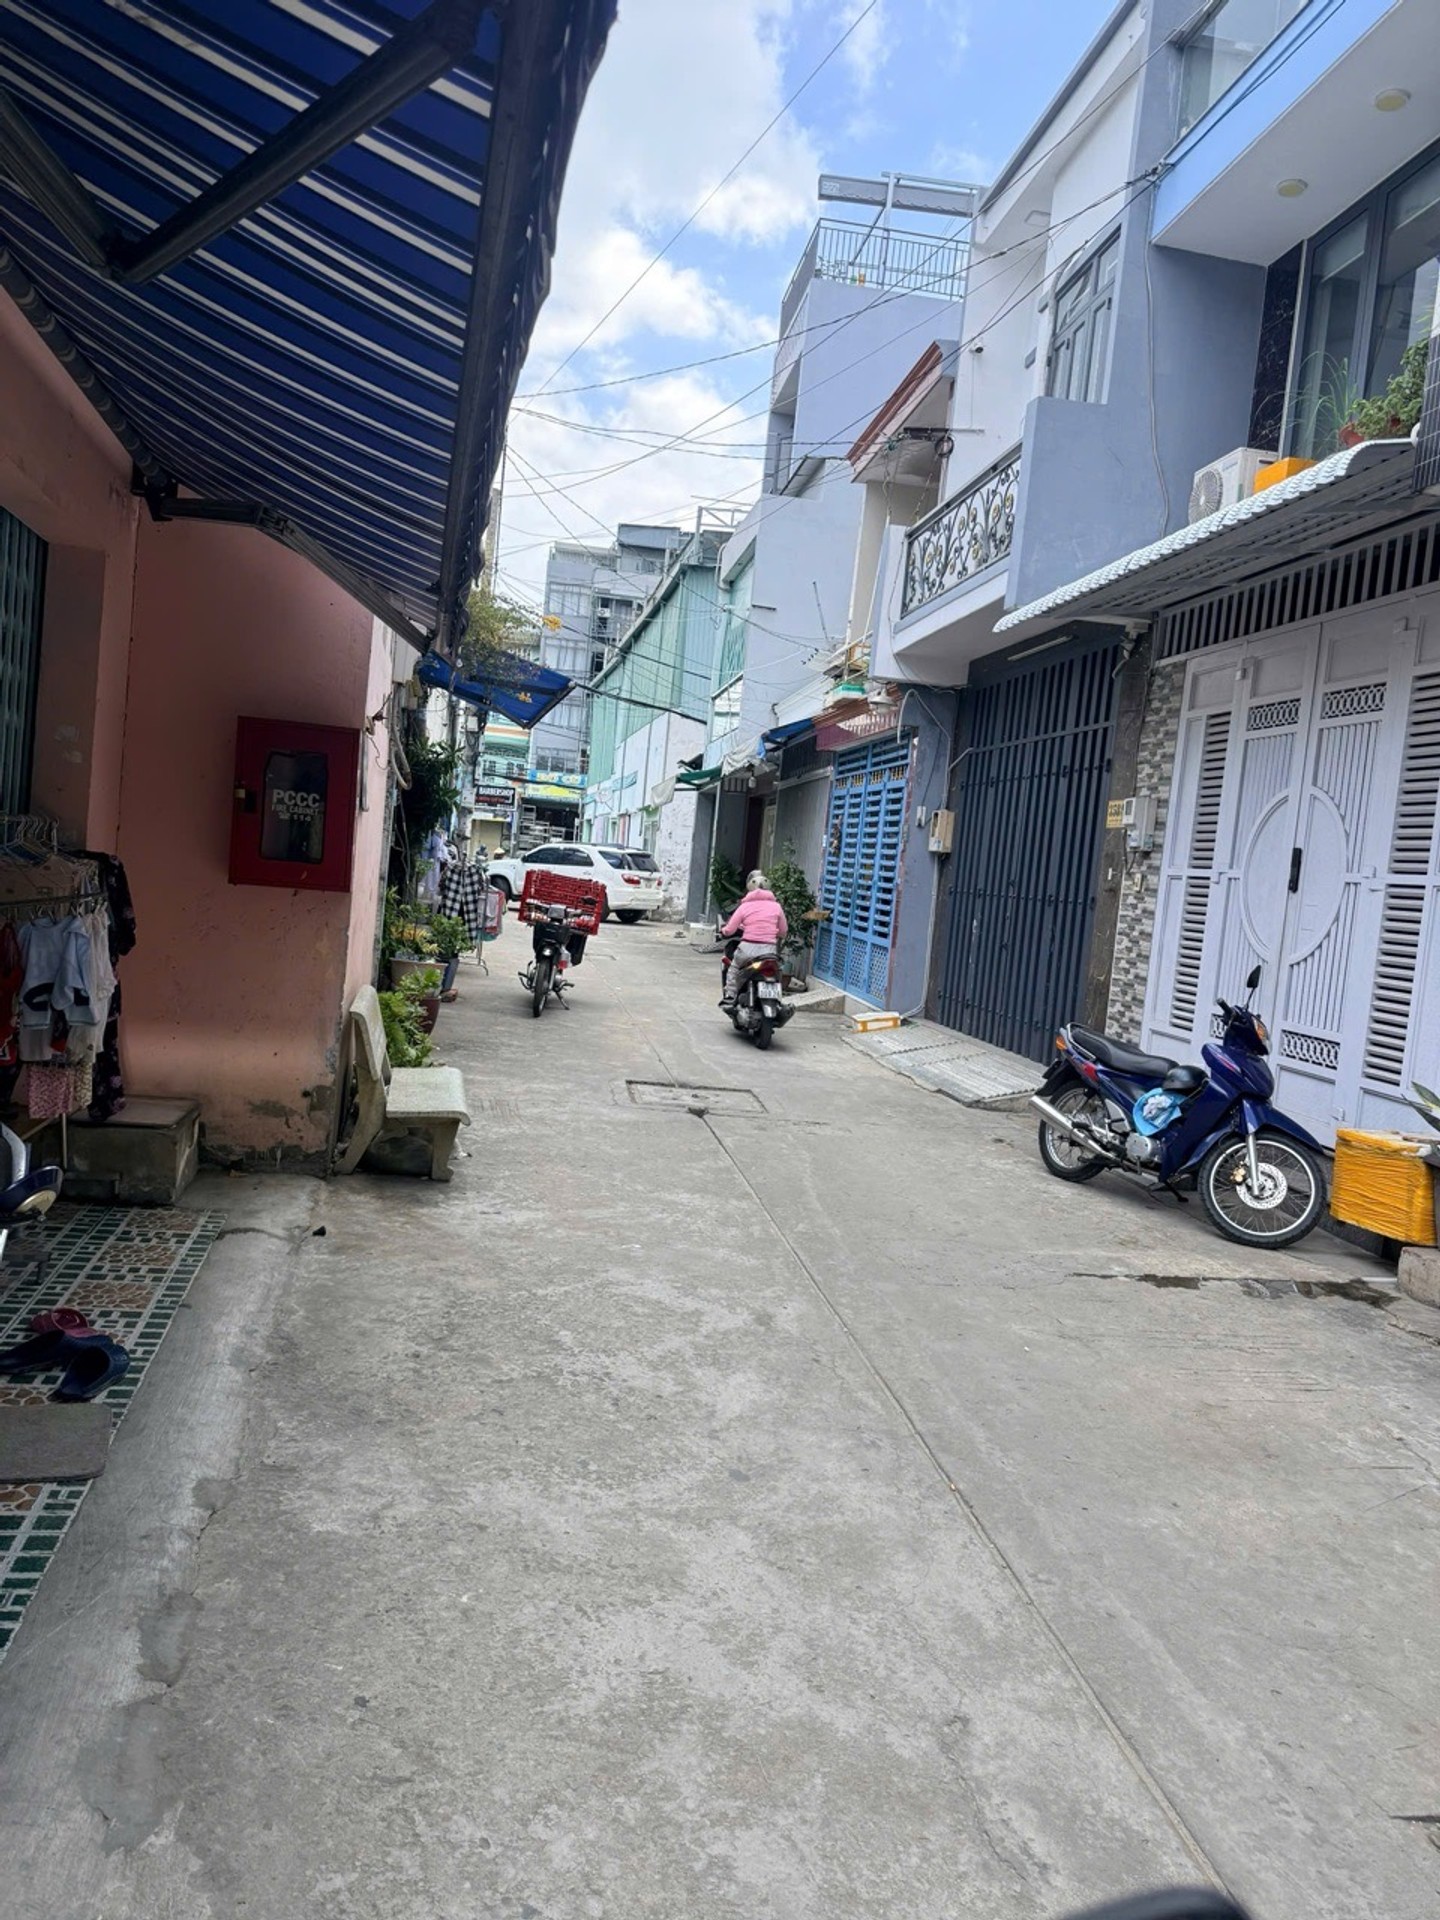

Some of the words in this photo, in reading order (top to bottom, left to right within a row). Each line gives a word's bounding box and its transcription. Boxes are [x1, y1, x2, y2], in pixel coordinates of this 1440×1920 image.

[272, 789, 320, 807] PCCC
[272, 804, 287, 812] FIRE
[289, 806, 319, 815] CABINET
